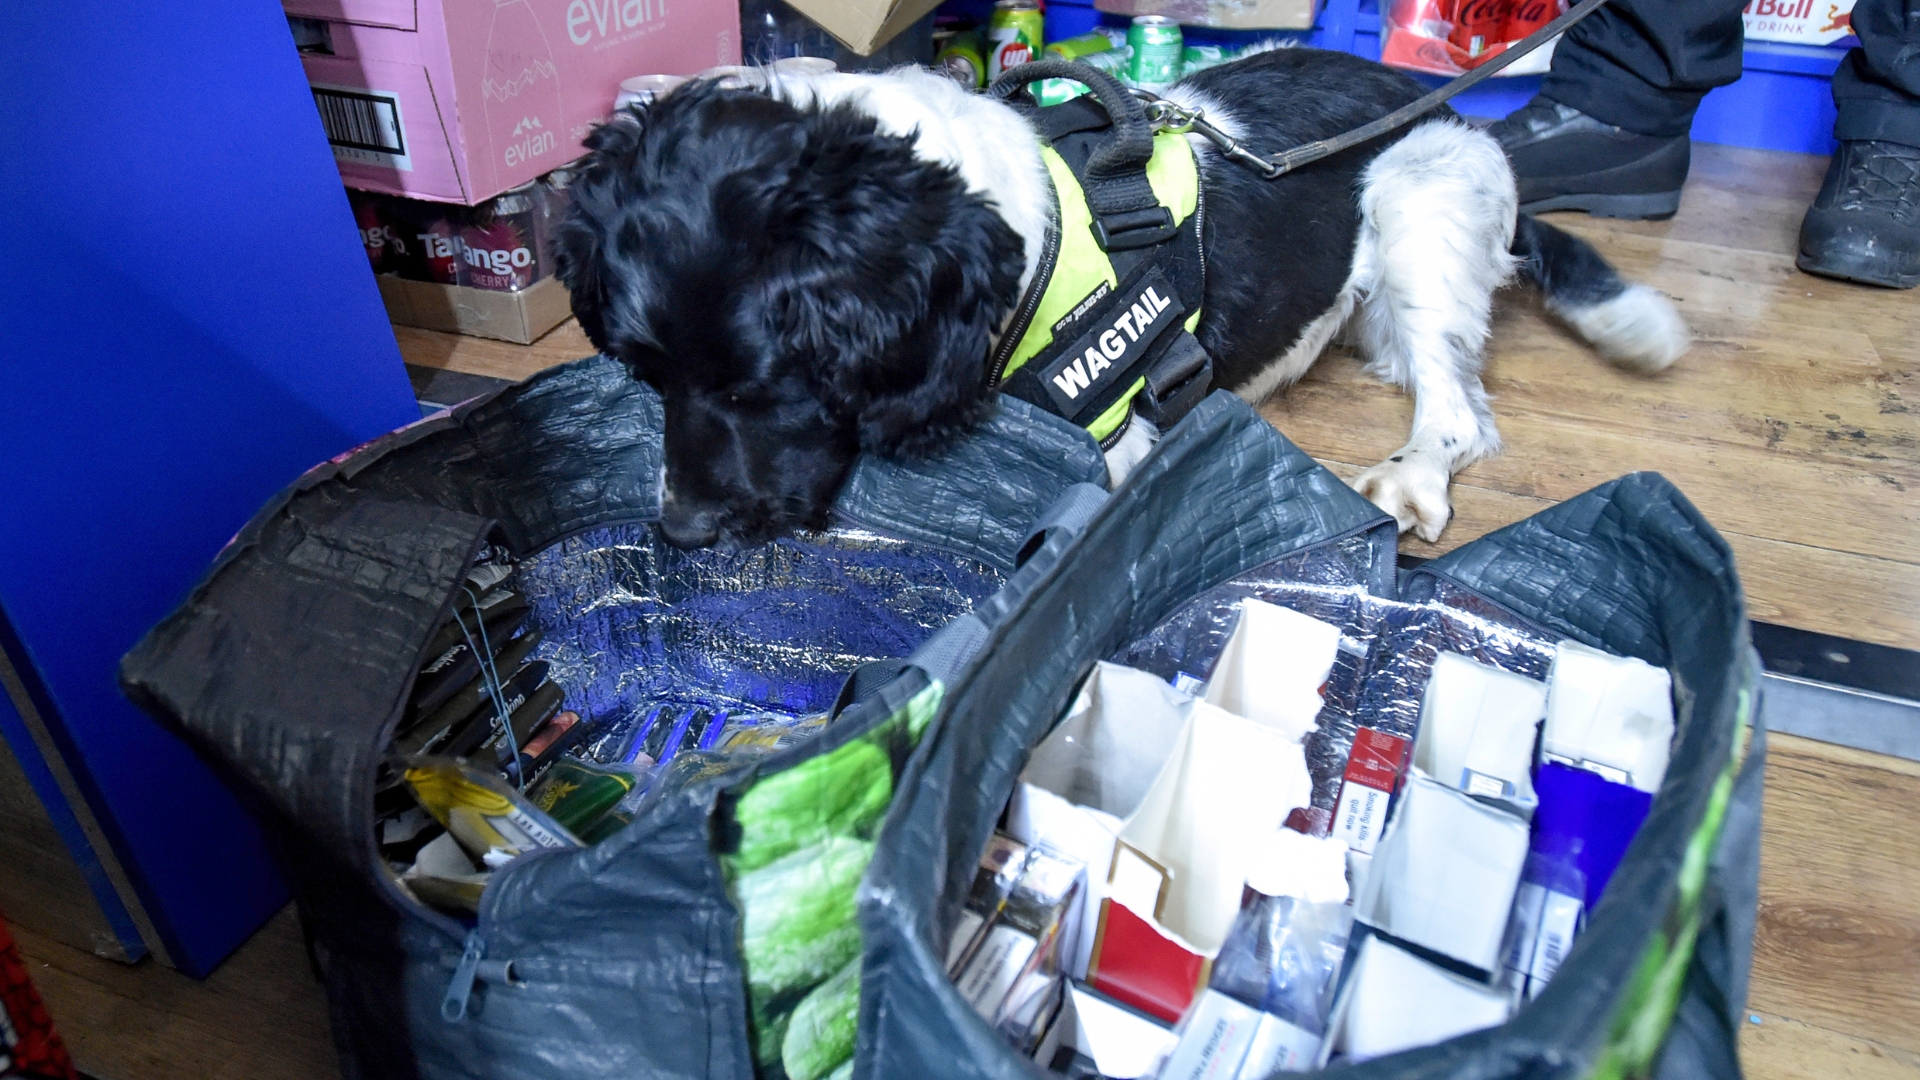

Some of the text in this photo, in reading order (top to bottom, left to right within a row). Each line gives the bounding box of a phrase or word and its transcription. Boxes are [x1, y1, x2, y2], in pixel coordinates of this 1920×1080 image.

[1756, 0, 1814, 18] Bull
[1757, 20, 1806, 34] DRINK
[504, 130, 556, 167] evian
[471, 271, 510, 288] CHERRY
[1052, 286, 1171, 400] WAGTAIL
[1346, 799, 1360, 831] quit now
[1360, 791, 1378, 823] Smoking
[1358, 823, 1371, 842] kills
